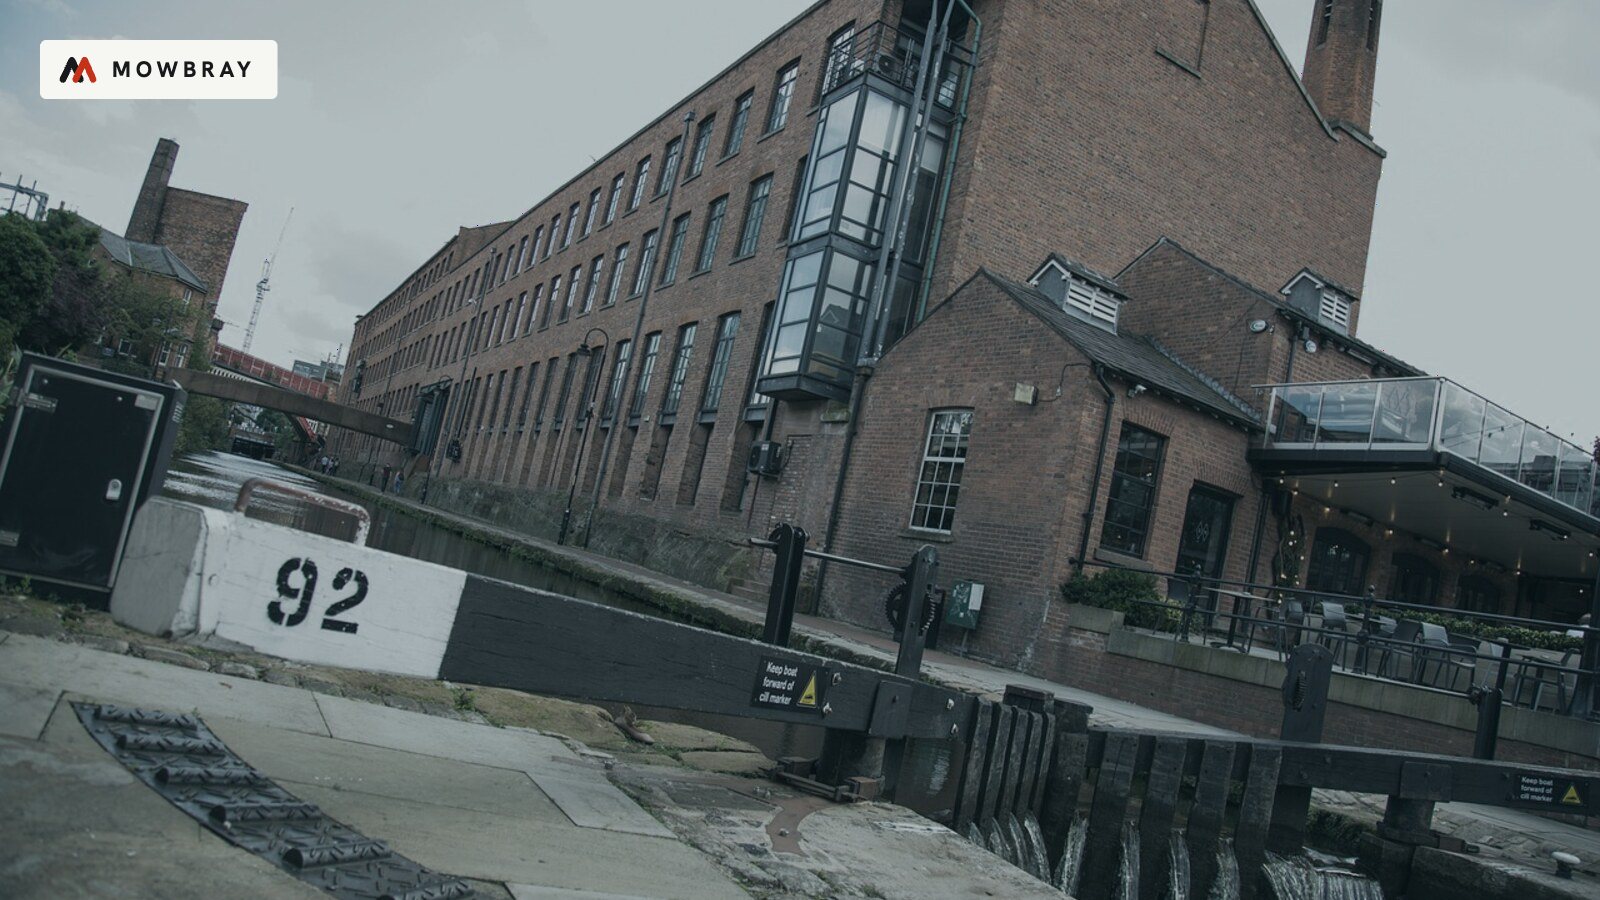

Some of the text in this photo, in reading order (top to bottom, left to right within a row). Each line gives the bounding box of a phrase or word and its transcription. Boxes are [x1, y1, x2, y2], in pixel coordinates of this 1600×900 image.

[267, 557, 369, 634] 92
[766, 661, 798, 677] Keep boat
[762, 676, 795, 691] forward of
[759, 691, 792, 705] cill marker
[1521, 776, 1537, 785] Keep
[1521, 785, 1545, 793] forward
